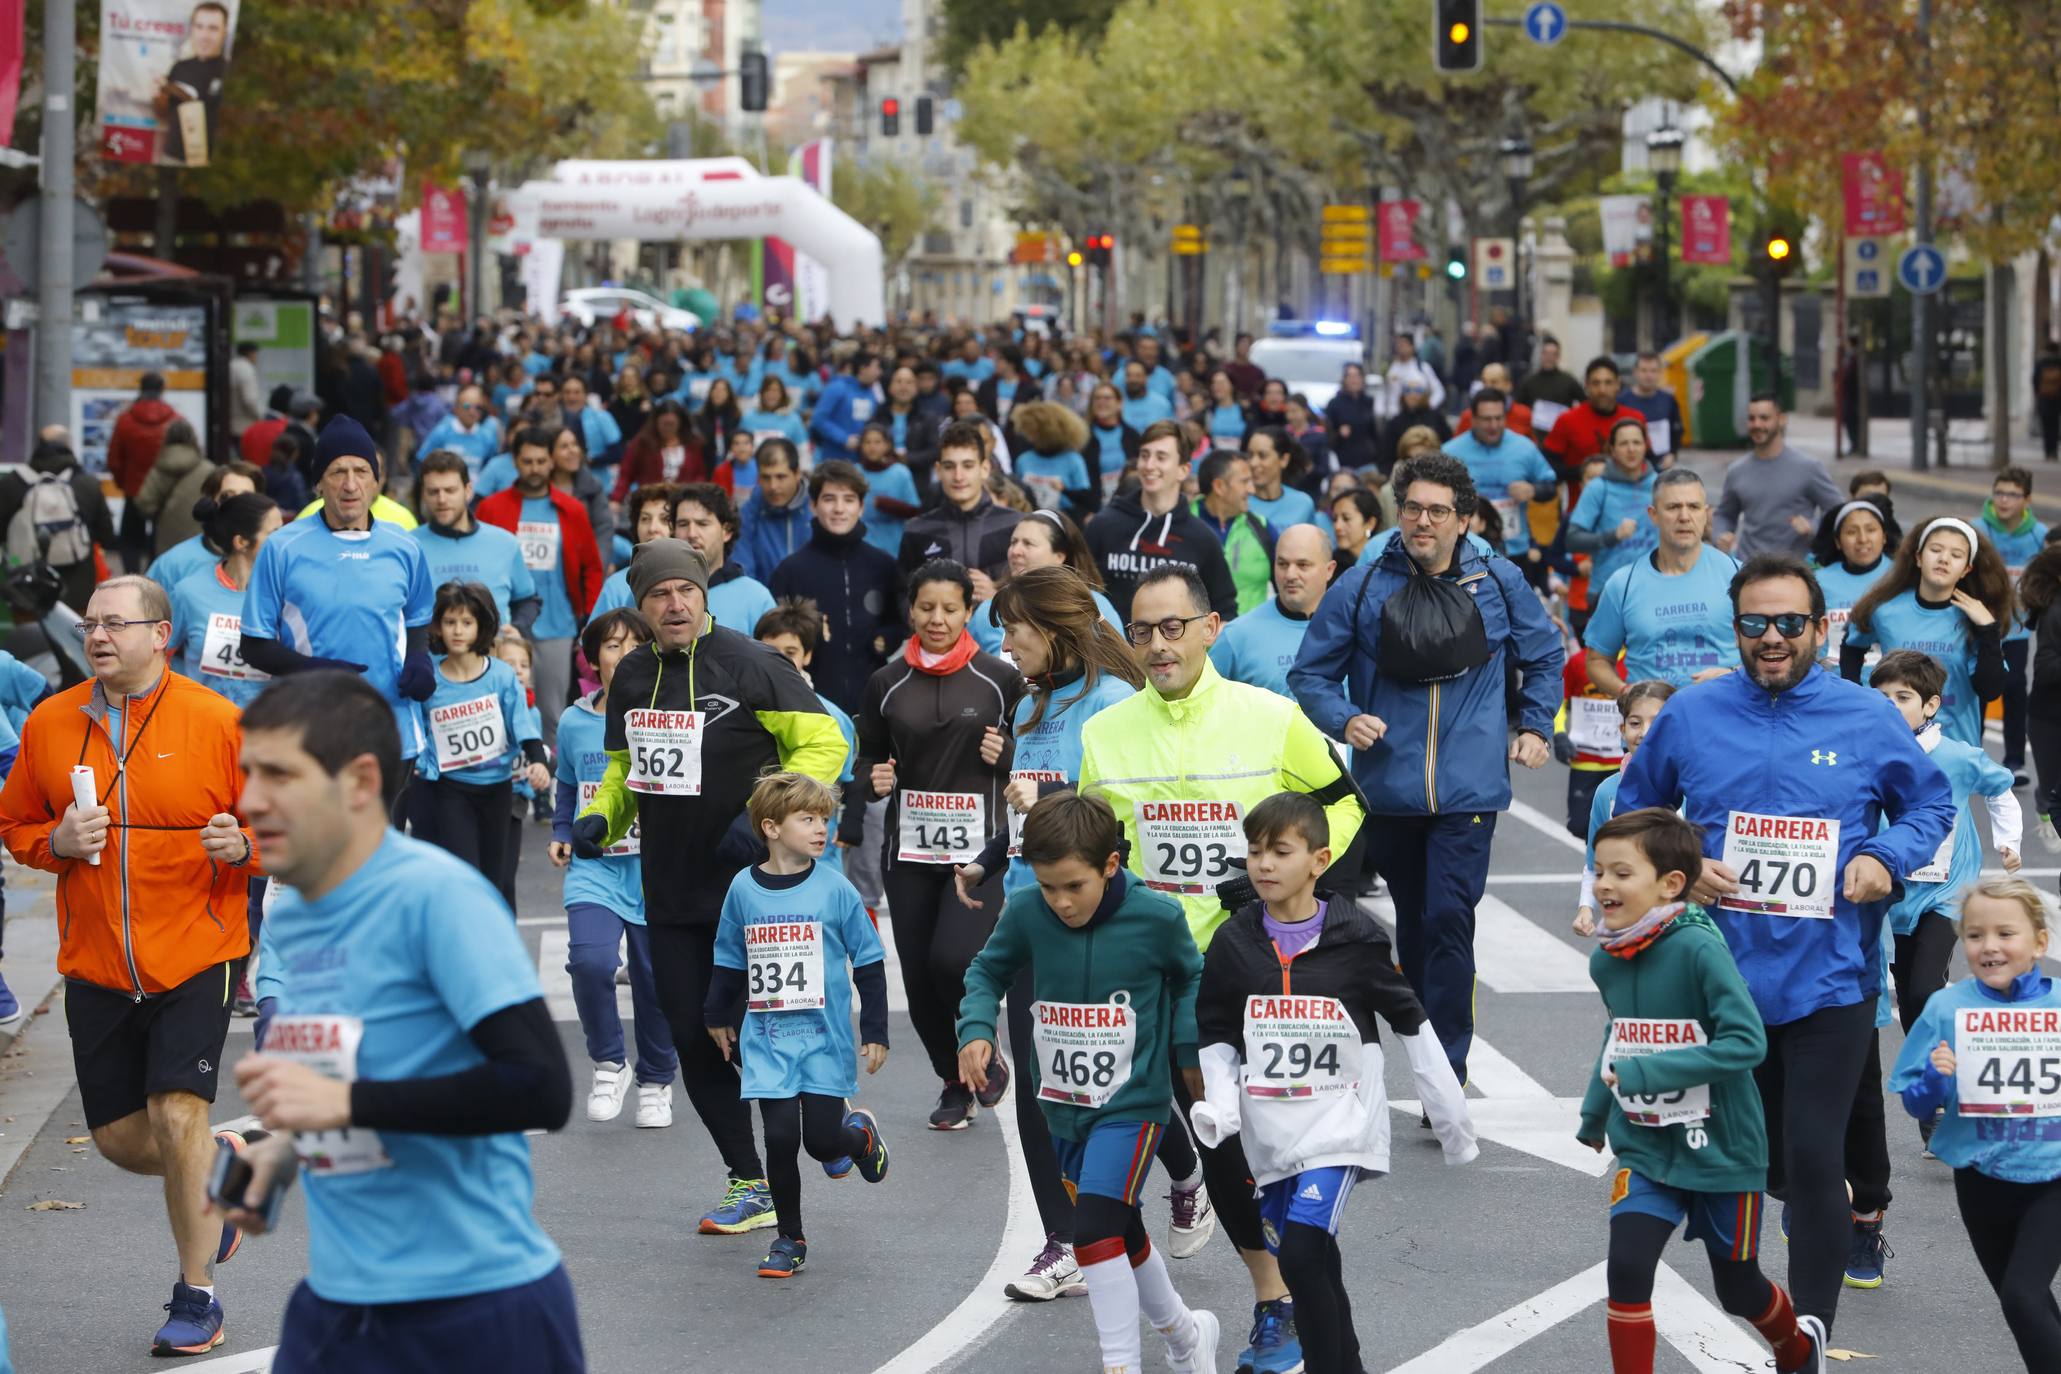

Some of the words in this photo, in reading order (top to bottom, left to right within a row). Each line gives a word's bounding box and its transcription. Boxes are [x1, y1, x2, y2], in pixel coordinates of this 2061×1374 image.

[1655, 602, 1708, 617] CARRERA
[1902, 640, 1954, 653] CARRERA
[434, 698, 494, 723] CARRERA
[1583, 701, 1617, 713] CARRE
[631, 711, 695, 730] CARRERA
[447, 725, 495, 756] 500
[637, 746, 684, 778] 562
[906, 793, 977, 811] CARRERA
[1143, 803, 1238, 821] CARRERA
[915, 824, 970, 850] 143
[1735, 815, 1829, 841] CARRERA
[1156, 842, 1229, 877] 293
[1739, 859, 1817, 898] 470
[1790, 904, 1825, 912] LABORAL
[745, 924, 815, 945] CARRERA
[750, 961, 807, 994] 334
[1040, 1004, 1127, 1028] CARRERA
[1966, 1012, 2061, 1033] CARRER
[263, 1023, 342, 1051] ARRERA
[1052, 1048, 1116, 1087] 468
[1262, 1042, 1340, 1079] 294
[1314, 1084, 1349, 1092] LABORAL
[1977, 1057, 2061, 1095] 445
